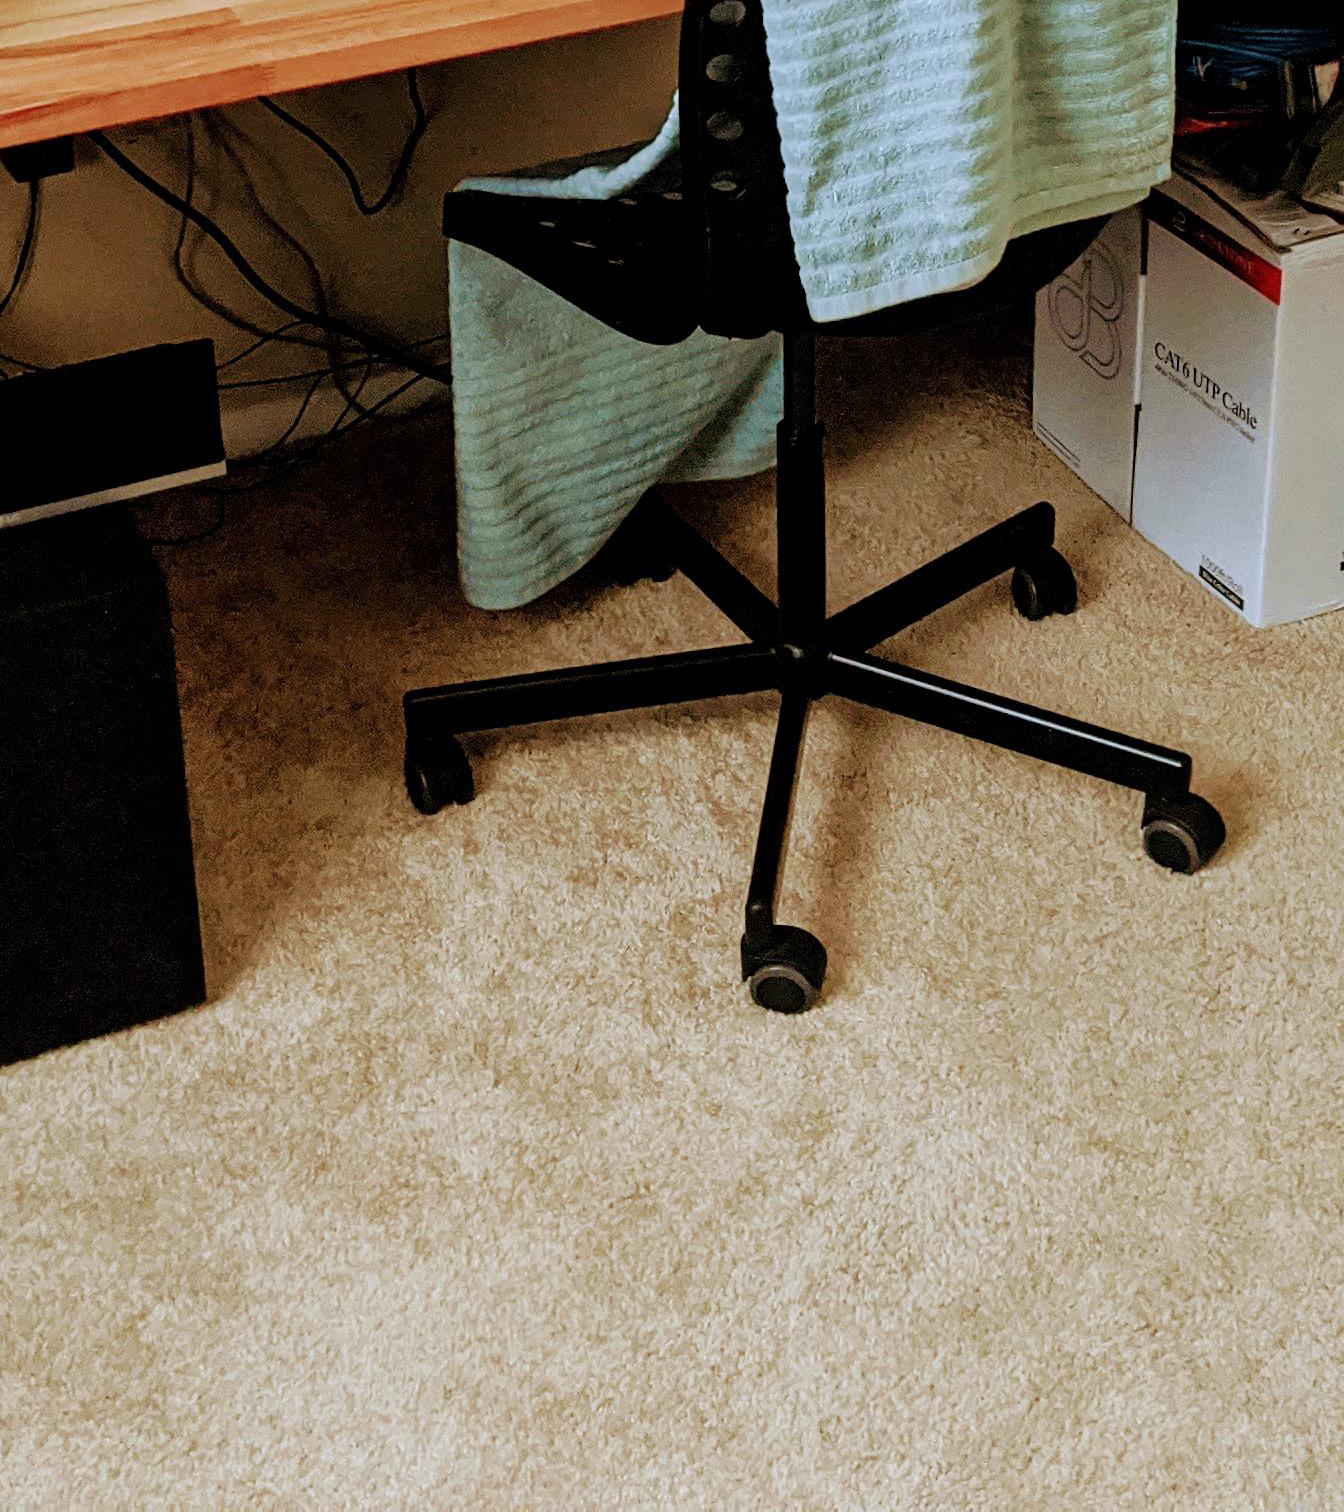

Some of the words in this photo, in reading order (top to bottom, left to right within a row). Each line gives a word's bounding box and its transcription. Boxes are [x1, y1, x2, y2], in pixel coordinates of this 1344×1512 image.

[1154, 341, 1191, 379] CAT6
[1192, 366, 1222, 400] UTP
[1221, 390, 1259, 430] Cable
